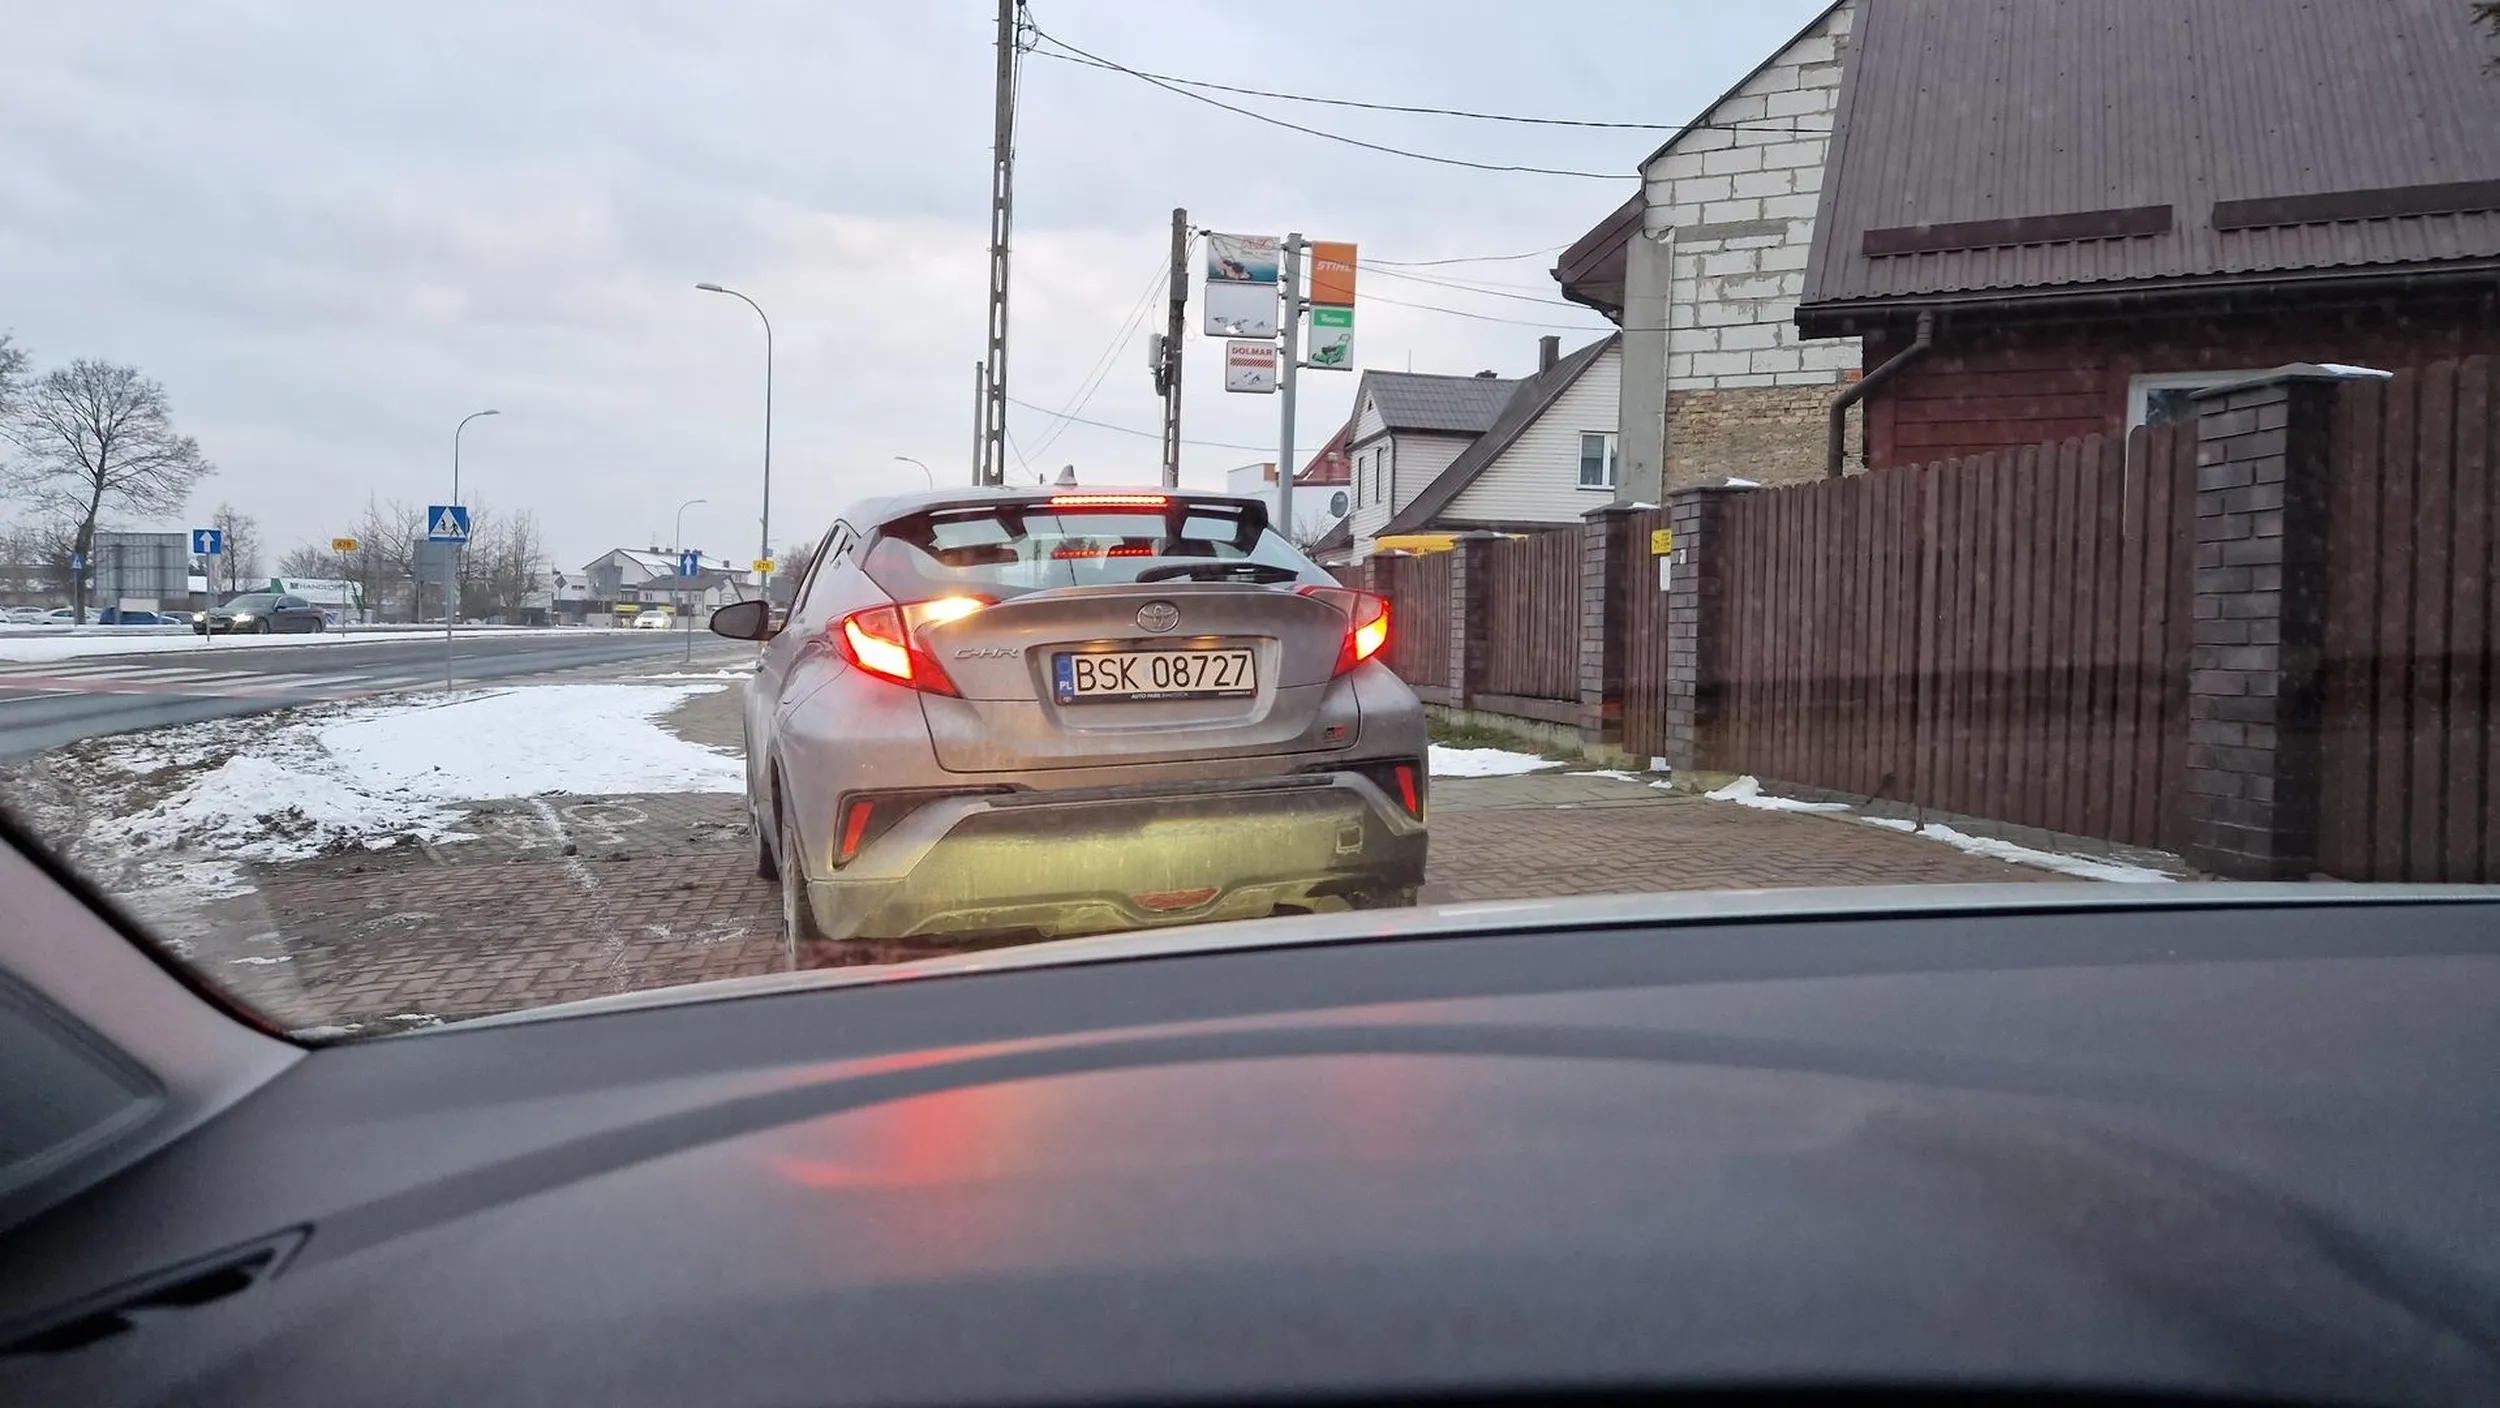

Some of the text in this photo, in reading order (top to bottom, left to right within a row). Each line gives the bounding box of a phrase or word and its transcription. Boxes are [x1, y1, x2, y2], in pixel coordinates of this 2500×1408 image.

[1232, 347, 1272, 355] DOLMAR
[1076, 655, 1248, 691] BSK 08727
[1059, 681, 1073, 690] PL
